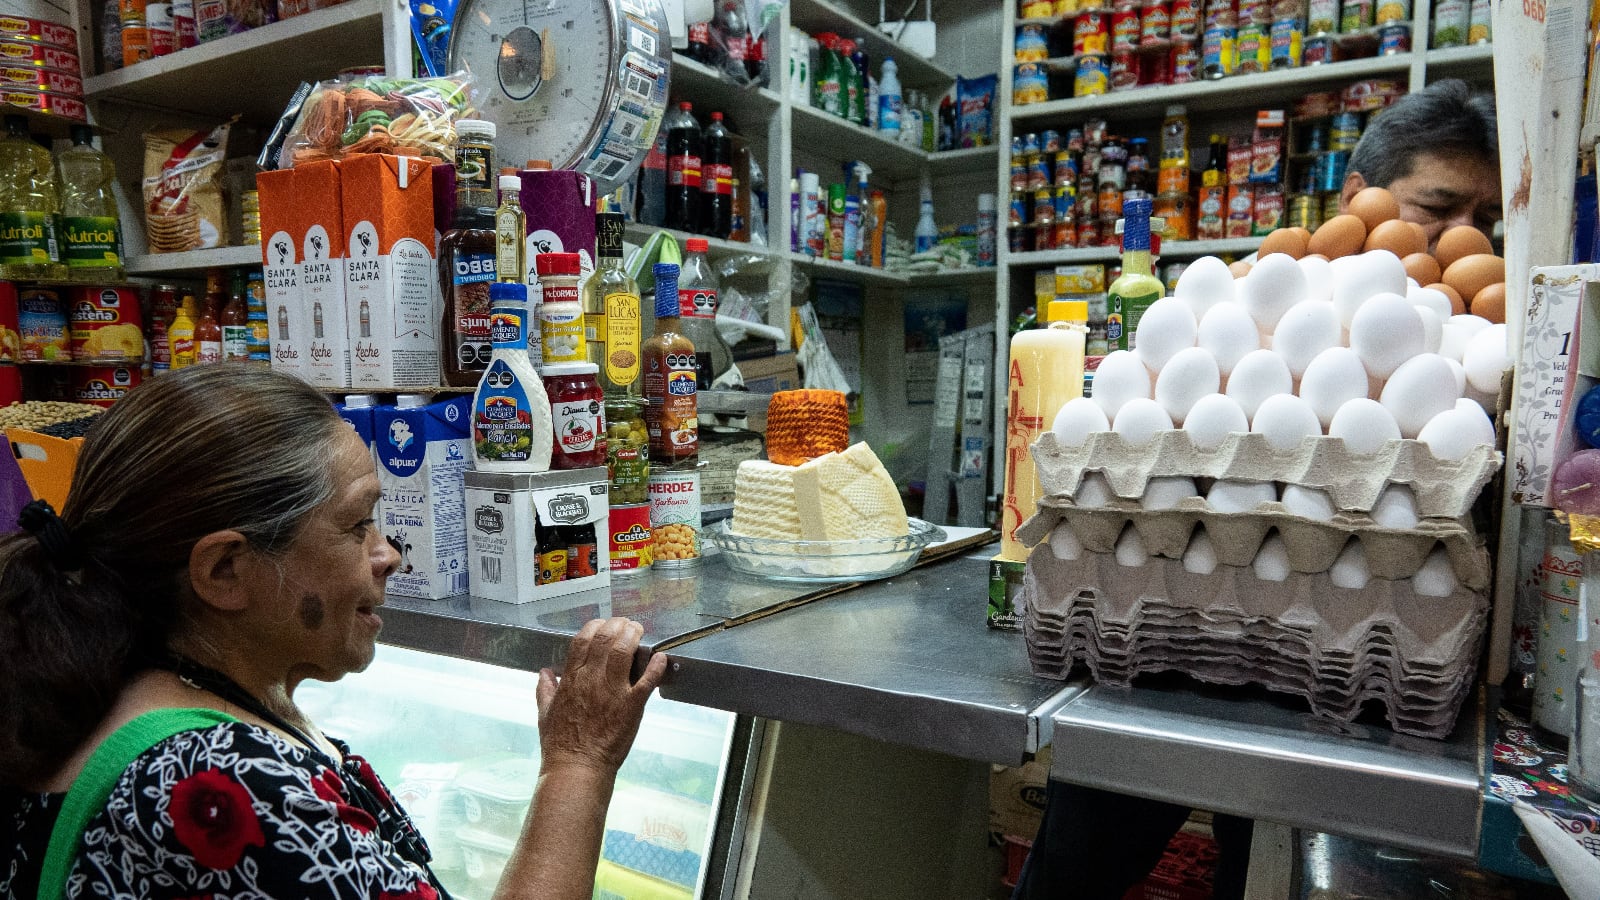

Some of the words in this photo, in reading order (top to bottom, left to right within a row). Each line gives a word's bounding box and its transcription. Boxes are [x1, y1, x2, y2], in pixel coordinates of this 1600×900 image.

[64, 229, 114, 243] Nutrioli
[304, 264, 331, 274] SANTA
[349, 261, 380, 271] SANTA
[456, 259, 495, 275] BBQ
[267, 269, 297, 278] SANTA
[349, 272, 380, 282] CLARA
[268, 279, 297, 288] CLARA
[304, 275, 331, 284] CLARA
[616, 297, 631, 307] SAN
[609, 306, 637, 319] LUCAS
[1009, 359, 1023, 386] A
[1543, 411, 1558, 420] Pro
[487, 430, 518, 443] Ranch
[389, 457, 416, 469] alpura
[648, 482, 694, 494] HERDEZ
[382, 492, 424, 504] CLÁSICA
[404, 519, 423, 527] REINA
